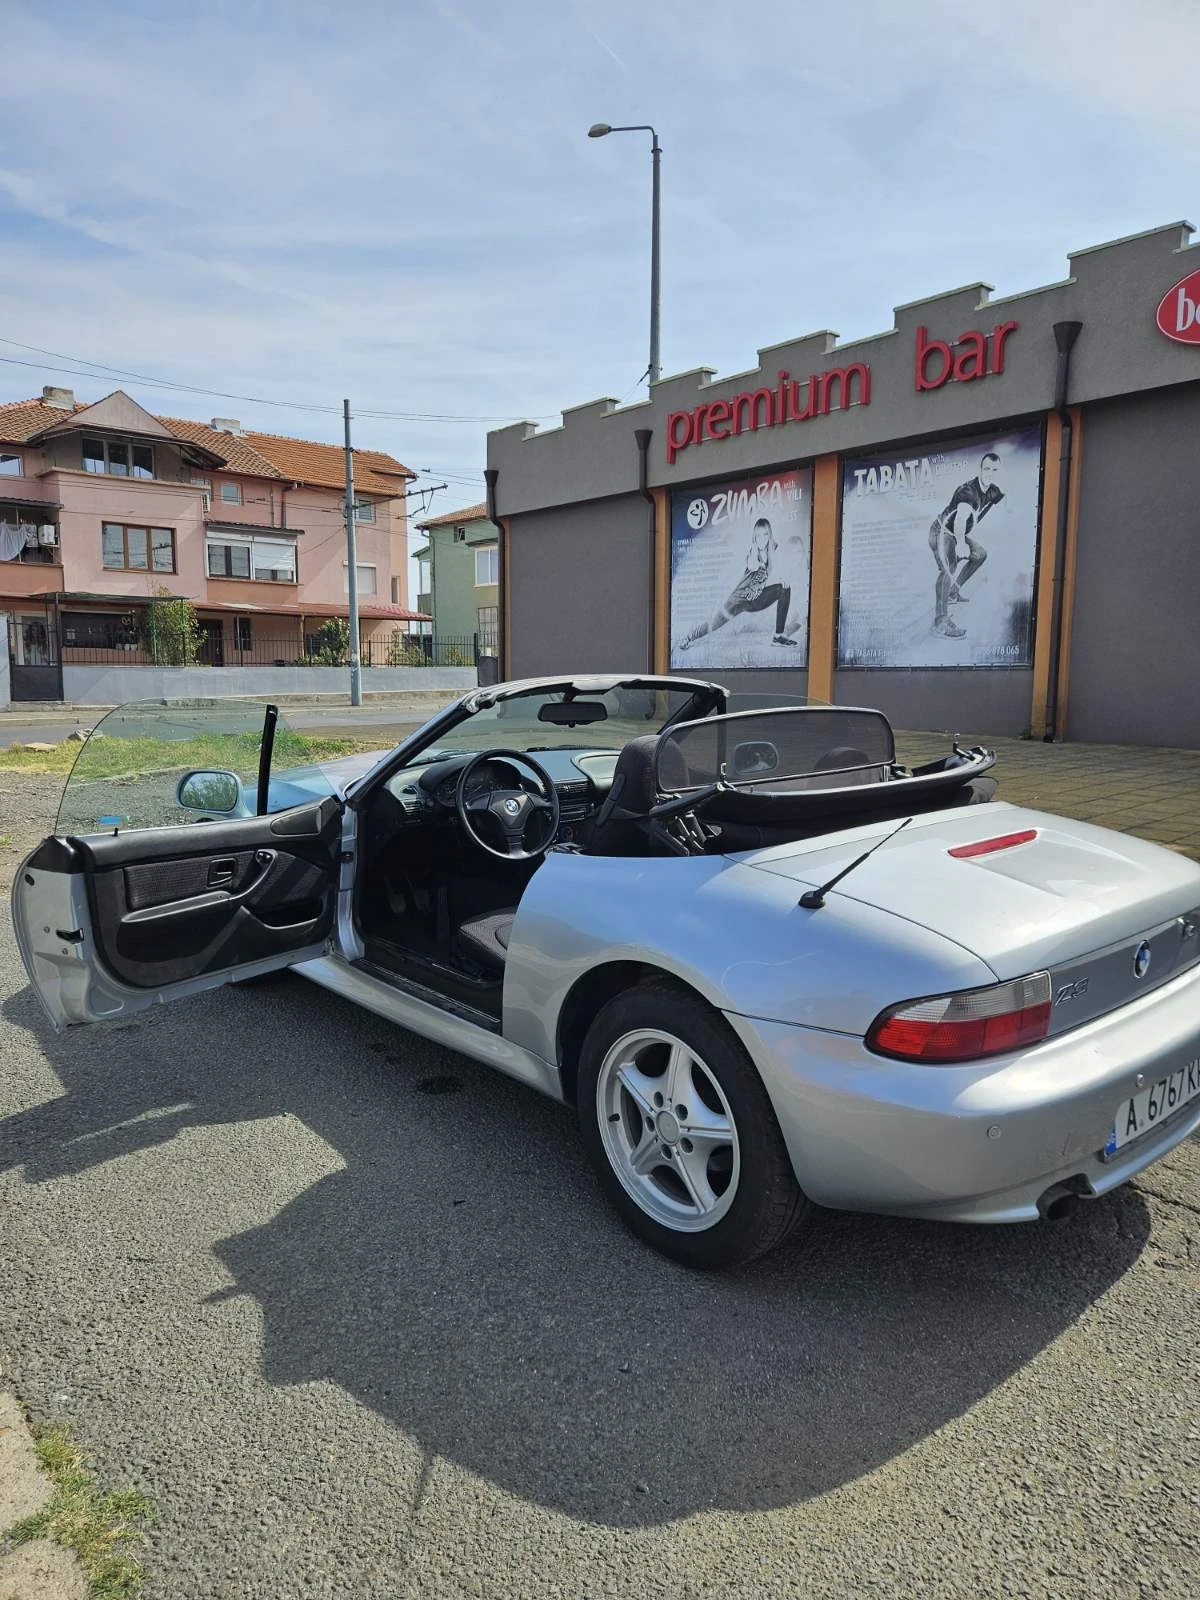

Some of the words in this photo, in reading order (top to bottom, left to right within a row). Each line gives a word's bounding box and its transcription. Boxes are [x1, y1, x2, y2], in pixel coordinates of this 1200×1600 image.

[666, 361, 871, 464] premium
[915, 321, 1018, 392] bar
[854, 457, 935, 497] TABATA
[710, 480, 784, 526] ZUMBA
[1055, 977, 1089, 1007] Z3
[1125, 1098, 1137, 1136] A
[1149, 1067, 1185, 1122] 6767
